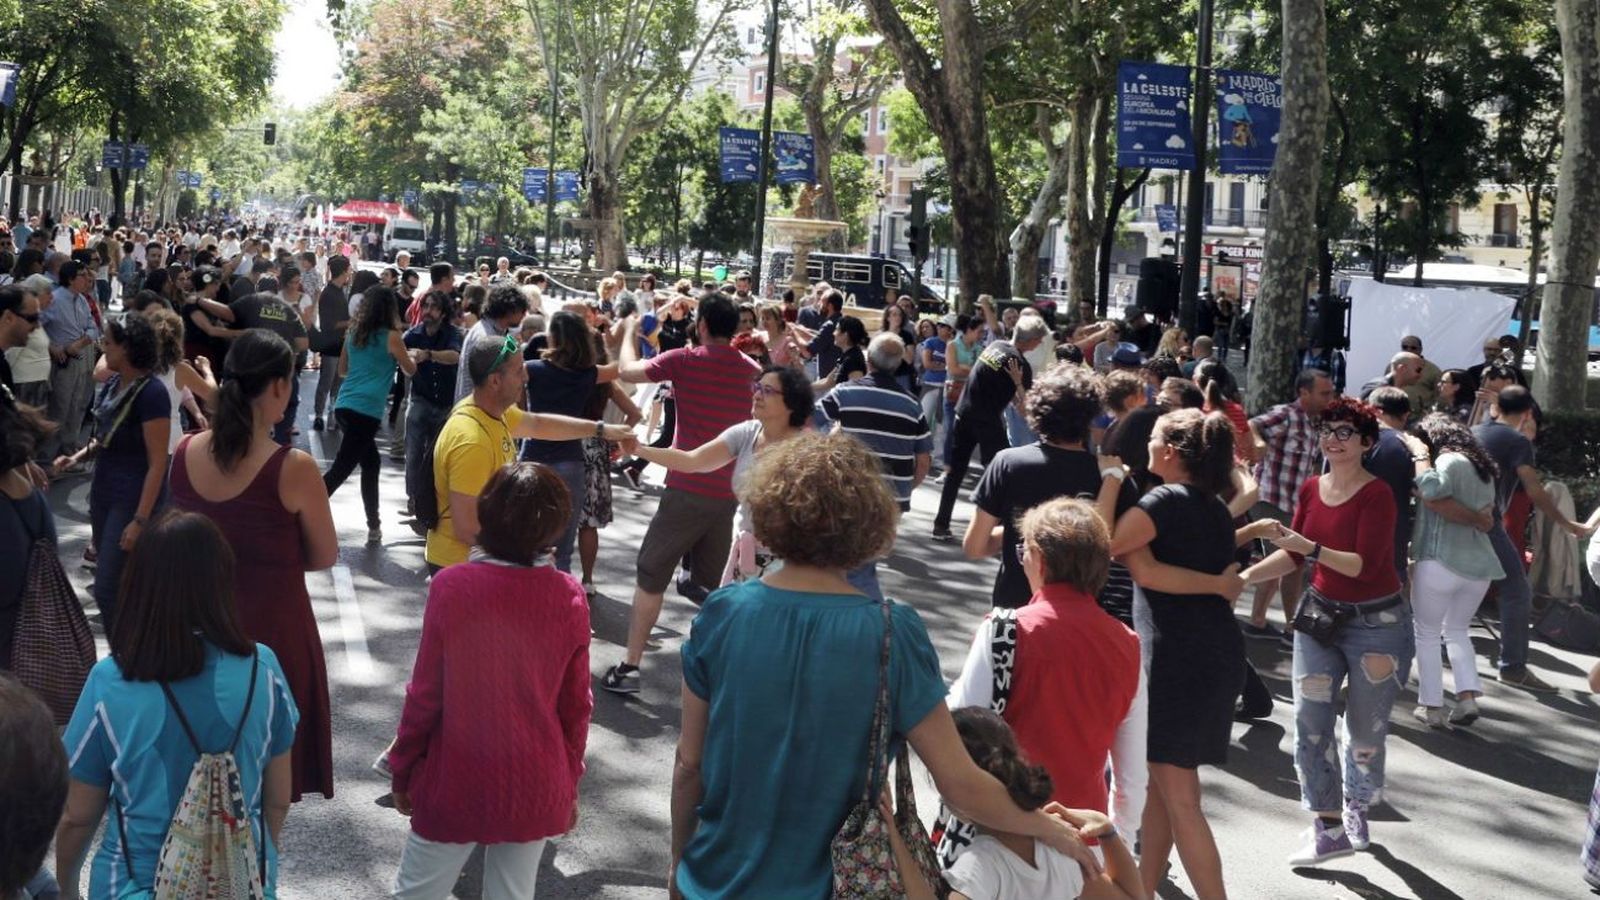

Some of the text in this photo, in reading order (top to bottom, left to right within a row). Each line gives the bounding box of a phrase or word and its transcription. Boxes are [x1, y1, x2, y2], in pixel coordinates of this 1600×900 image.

[1123, 82, 1187, 98] LA CELESTE
[1229, 75, 1275, 93] MADRID
[1148, 157, 1178, 165] MADRID
